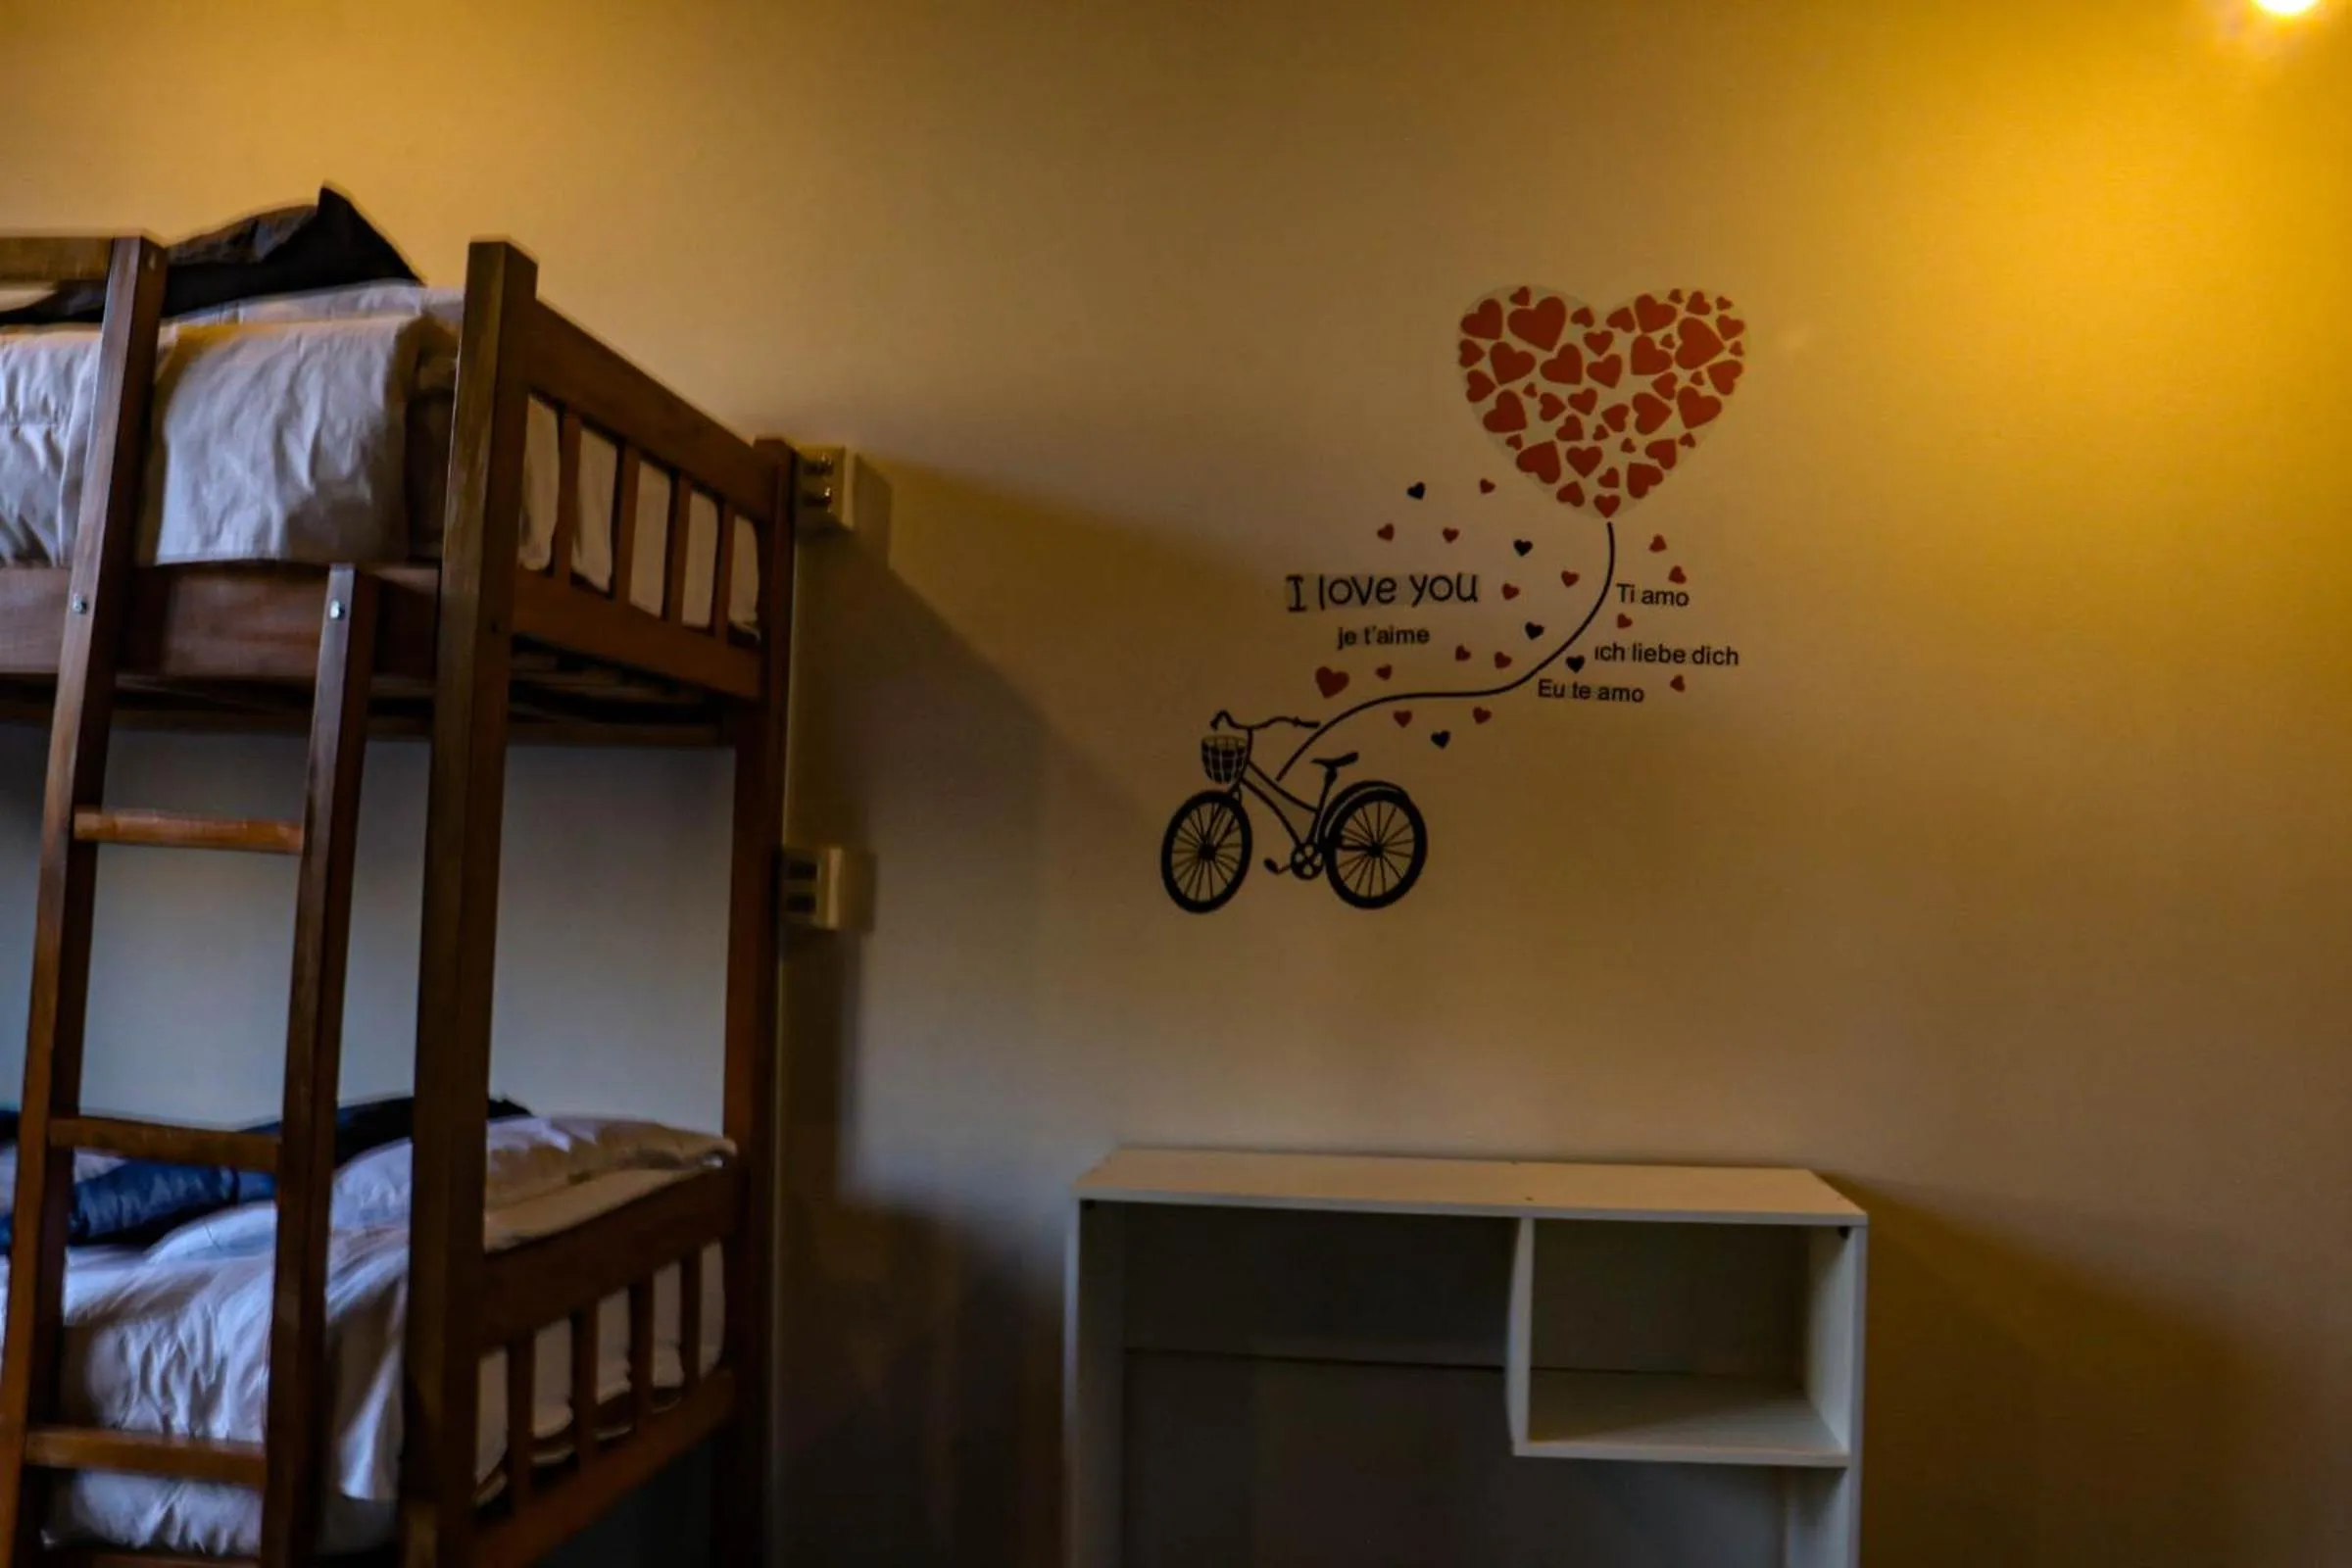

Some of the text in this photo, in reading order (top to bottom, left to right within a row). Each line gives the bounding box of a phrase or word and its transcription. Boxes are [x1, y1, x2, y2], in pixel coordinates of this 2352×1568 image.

[1286, 572, 1478, 612] I love you
[1616, 583, 1690, 607] Ti amo
[1337, 625, 1430, 651] je t'aime
[1632, 642, 1686, 664] liebe
[1691, 645, 1740, 666] dich
[1538, 678, 1645, 703] Eu te amo
